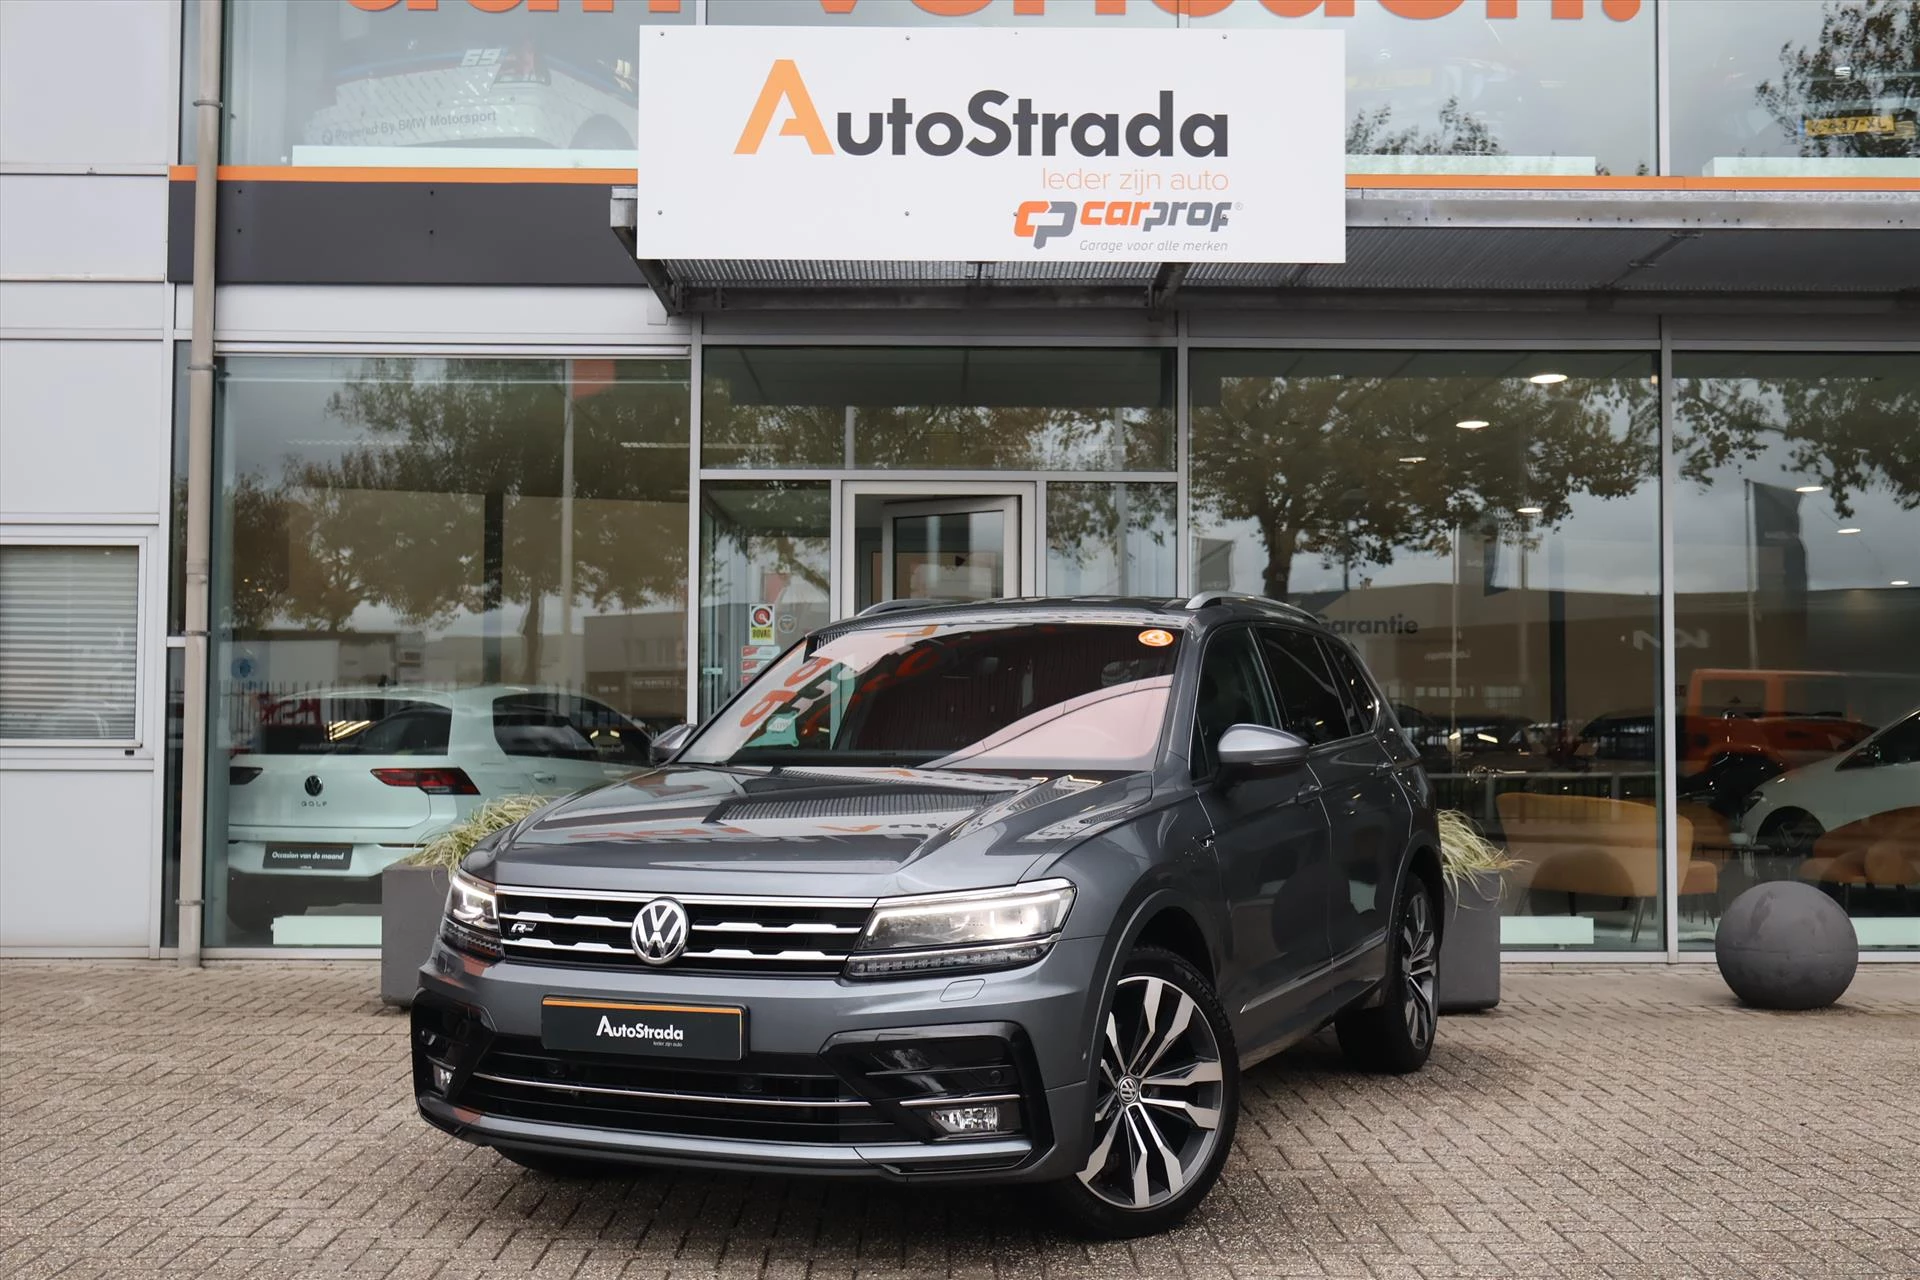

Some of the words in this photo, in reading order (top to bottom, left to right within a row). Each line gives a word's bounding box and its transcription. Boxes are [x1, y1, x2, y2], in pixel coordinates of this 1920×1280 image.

[461, 49, 501, 66] 69
[734, 59, 1228, 157] AutoStrada
[334, 123, 378, 139] Powered
[380, 120, 395, 134] By
[398, 117, 426, 131] BMW
[430, 110, 497, 127] Motorsport
[1043, 167, 1110, 189] Ieder
[1120, 169, 1161, 196] zijn
[1171, 170, 1229, 190] auto
[1080, 201, 1232, 232] carprof
[1079, 240, 1122, 253] Garage
[1127, 243, 1153, 252] voor
[1157, 240, 1179, 251] alle
[1183, 240, 1228, 251] merken
[301, 800, 327, 808] GOLF
[271, 851, 299, 859] Occasion
[321, 852, 344, 861] maand
[596, 1015, 684, 1040] AutoStrada
